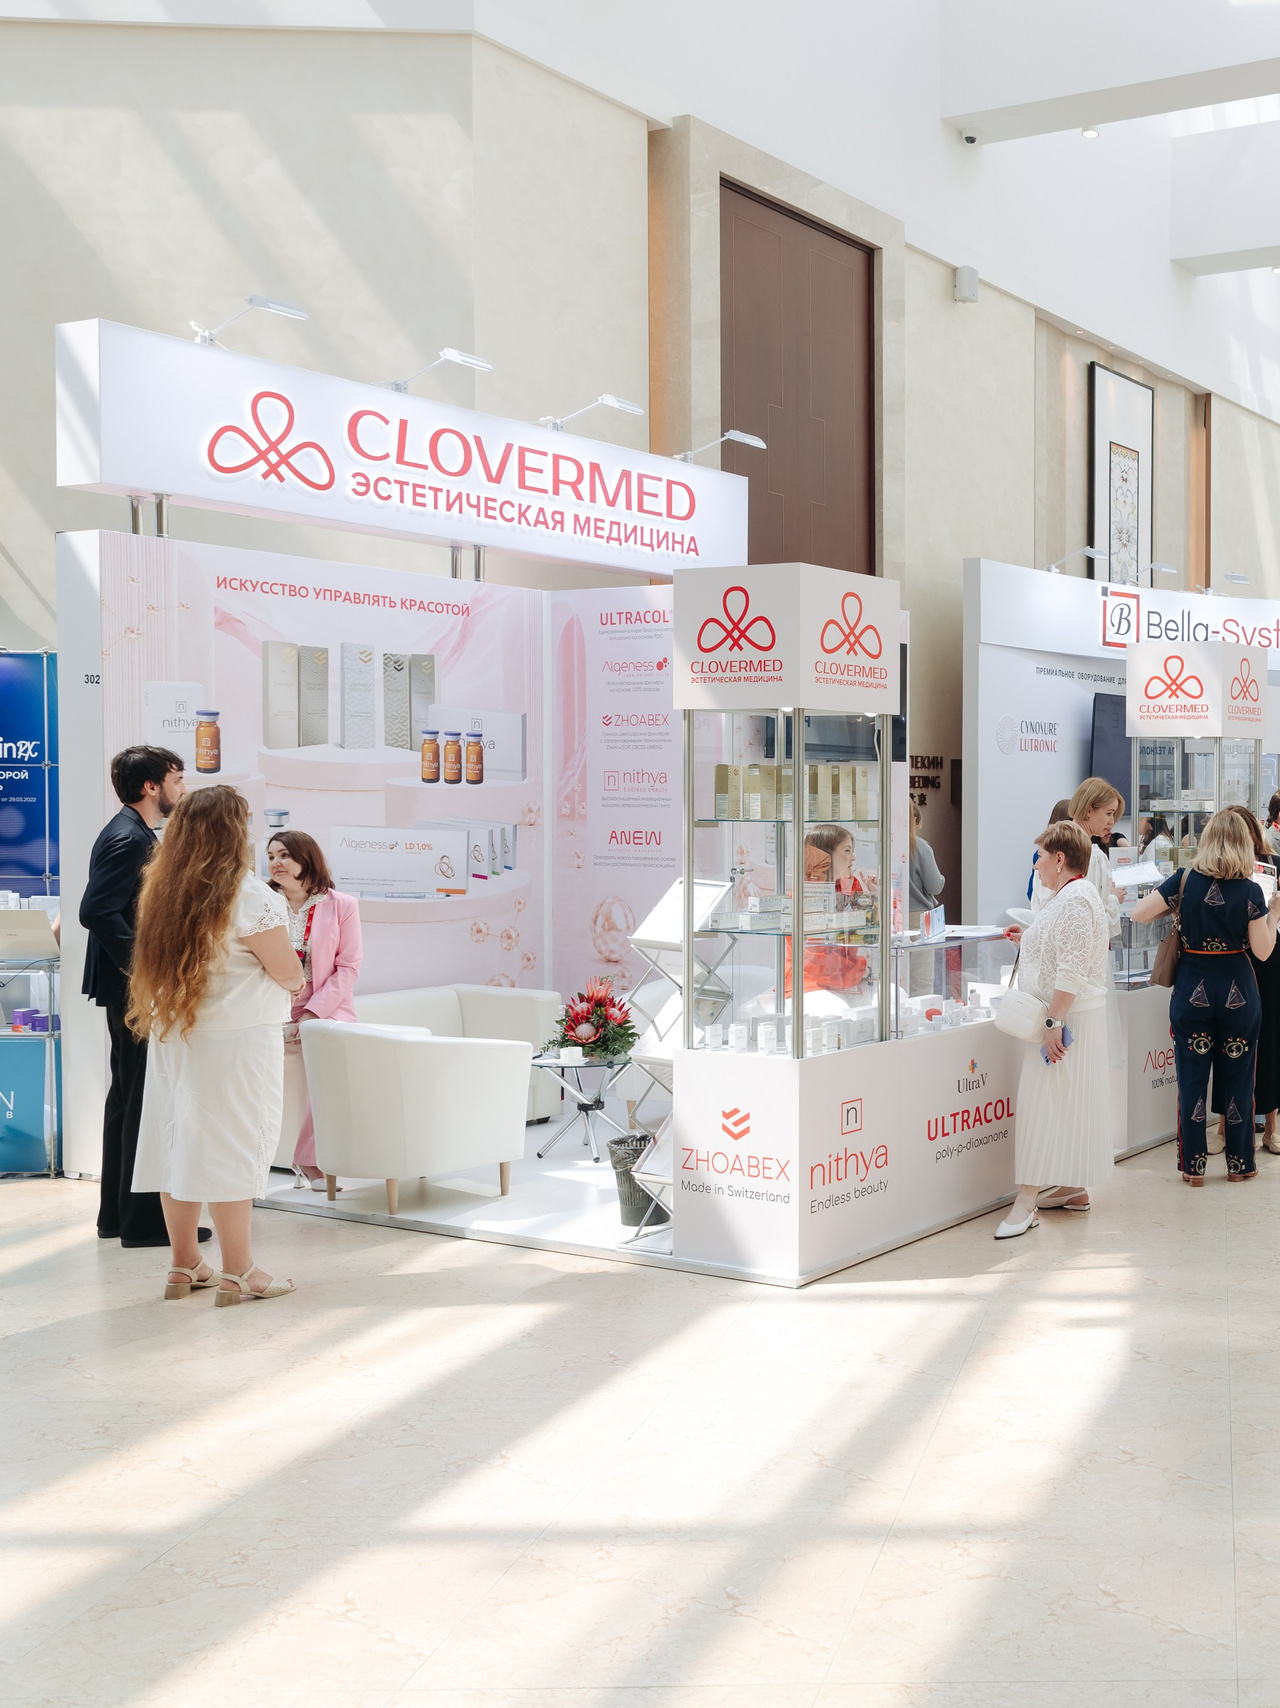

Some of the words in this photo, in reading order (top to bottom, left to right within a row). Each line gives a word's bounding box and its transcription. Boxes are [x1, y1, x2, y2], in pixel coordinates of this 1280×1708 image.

[347, 410, 697, 521] CLOVERMED
[351, 472, 565, 533] ЭСТЕТИЧЕСКАЯ
[573, 515, 700, 557] МЕДИЦИНА
[216, 576, 309, 600] ИСКУССТВО
[312, 587, 397, 609] УПРАВЛЯТЬ
[400, 596, 470, 617] КРАСОТОЙ
[600, 610, 670, 626] ULTRACOL
[690, 658, 783, 674] CLOVERMED
[814, 660, 888, 680] CLOVERMED
[84, 674, 100, 685] 302
[690, 676, 742, 684] ЭСТЕТИЧЕСКАЯ
[743, 675, 783, 683] МЕДИЦИНА
[814, 676, 856, 686] ЭСТЕТИЧЕСКАЯ
[858, 681, 888, 689] МЕДИЦИНА
[1036, 667, 1075, 679] ПРЕМИАЛЬНОЕ
[1077, 672, 1116, 684] ОБОРУДОВАНИЕ
[1139, 704, 1209, 714] CLOVERMED
[1228, 704, 1262, 716] CLOVERMED
[162, 717, 199, 729] nithya
[614, 714, 670, 726] ZHOABEX
[1020, 738, 1058, 753] LUTRONIC
[622, 768, 668, 787] nithya
[339, 837, 388, 851] Algeness
[405, 842, 415, 850] LD
[416, 842, 433, 851] 1,0%
[608, 830, 662, 846] ANEW
[1143, 1048, 1175, 1075] Alge
[957, 1078, 980, 1093] Ultra
[981, 1072, 988, 1087] V
[927, 1097, 1014, 1141] ULTRACOL
[935, 1129, 1008, 1164] poly-p-dioxanone
[682, 1147, 790, 1182] ZHOABEX
[810, 1144, 888, 1190] nithya
[681, 1180, 711, 1194] Made
[714, 1184, 724, 1196] in
[728, 1185, 790, 1204] Switzerland
[810, 1191, 851, 1214] Endless
[854, 1179, 889, 1199] beauty
